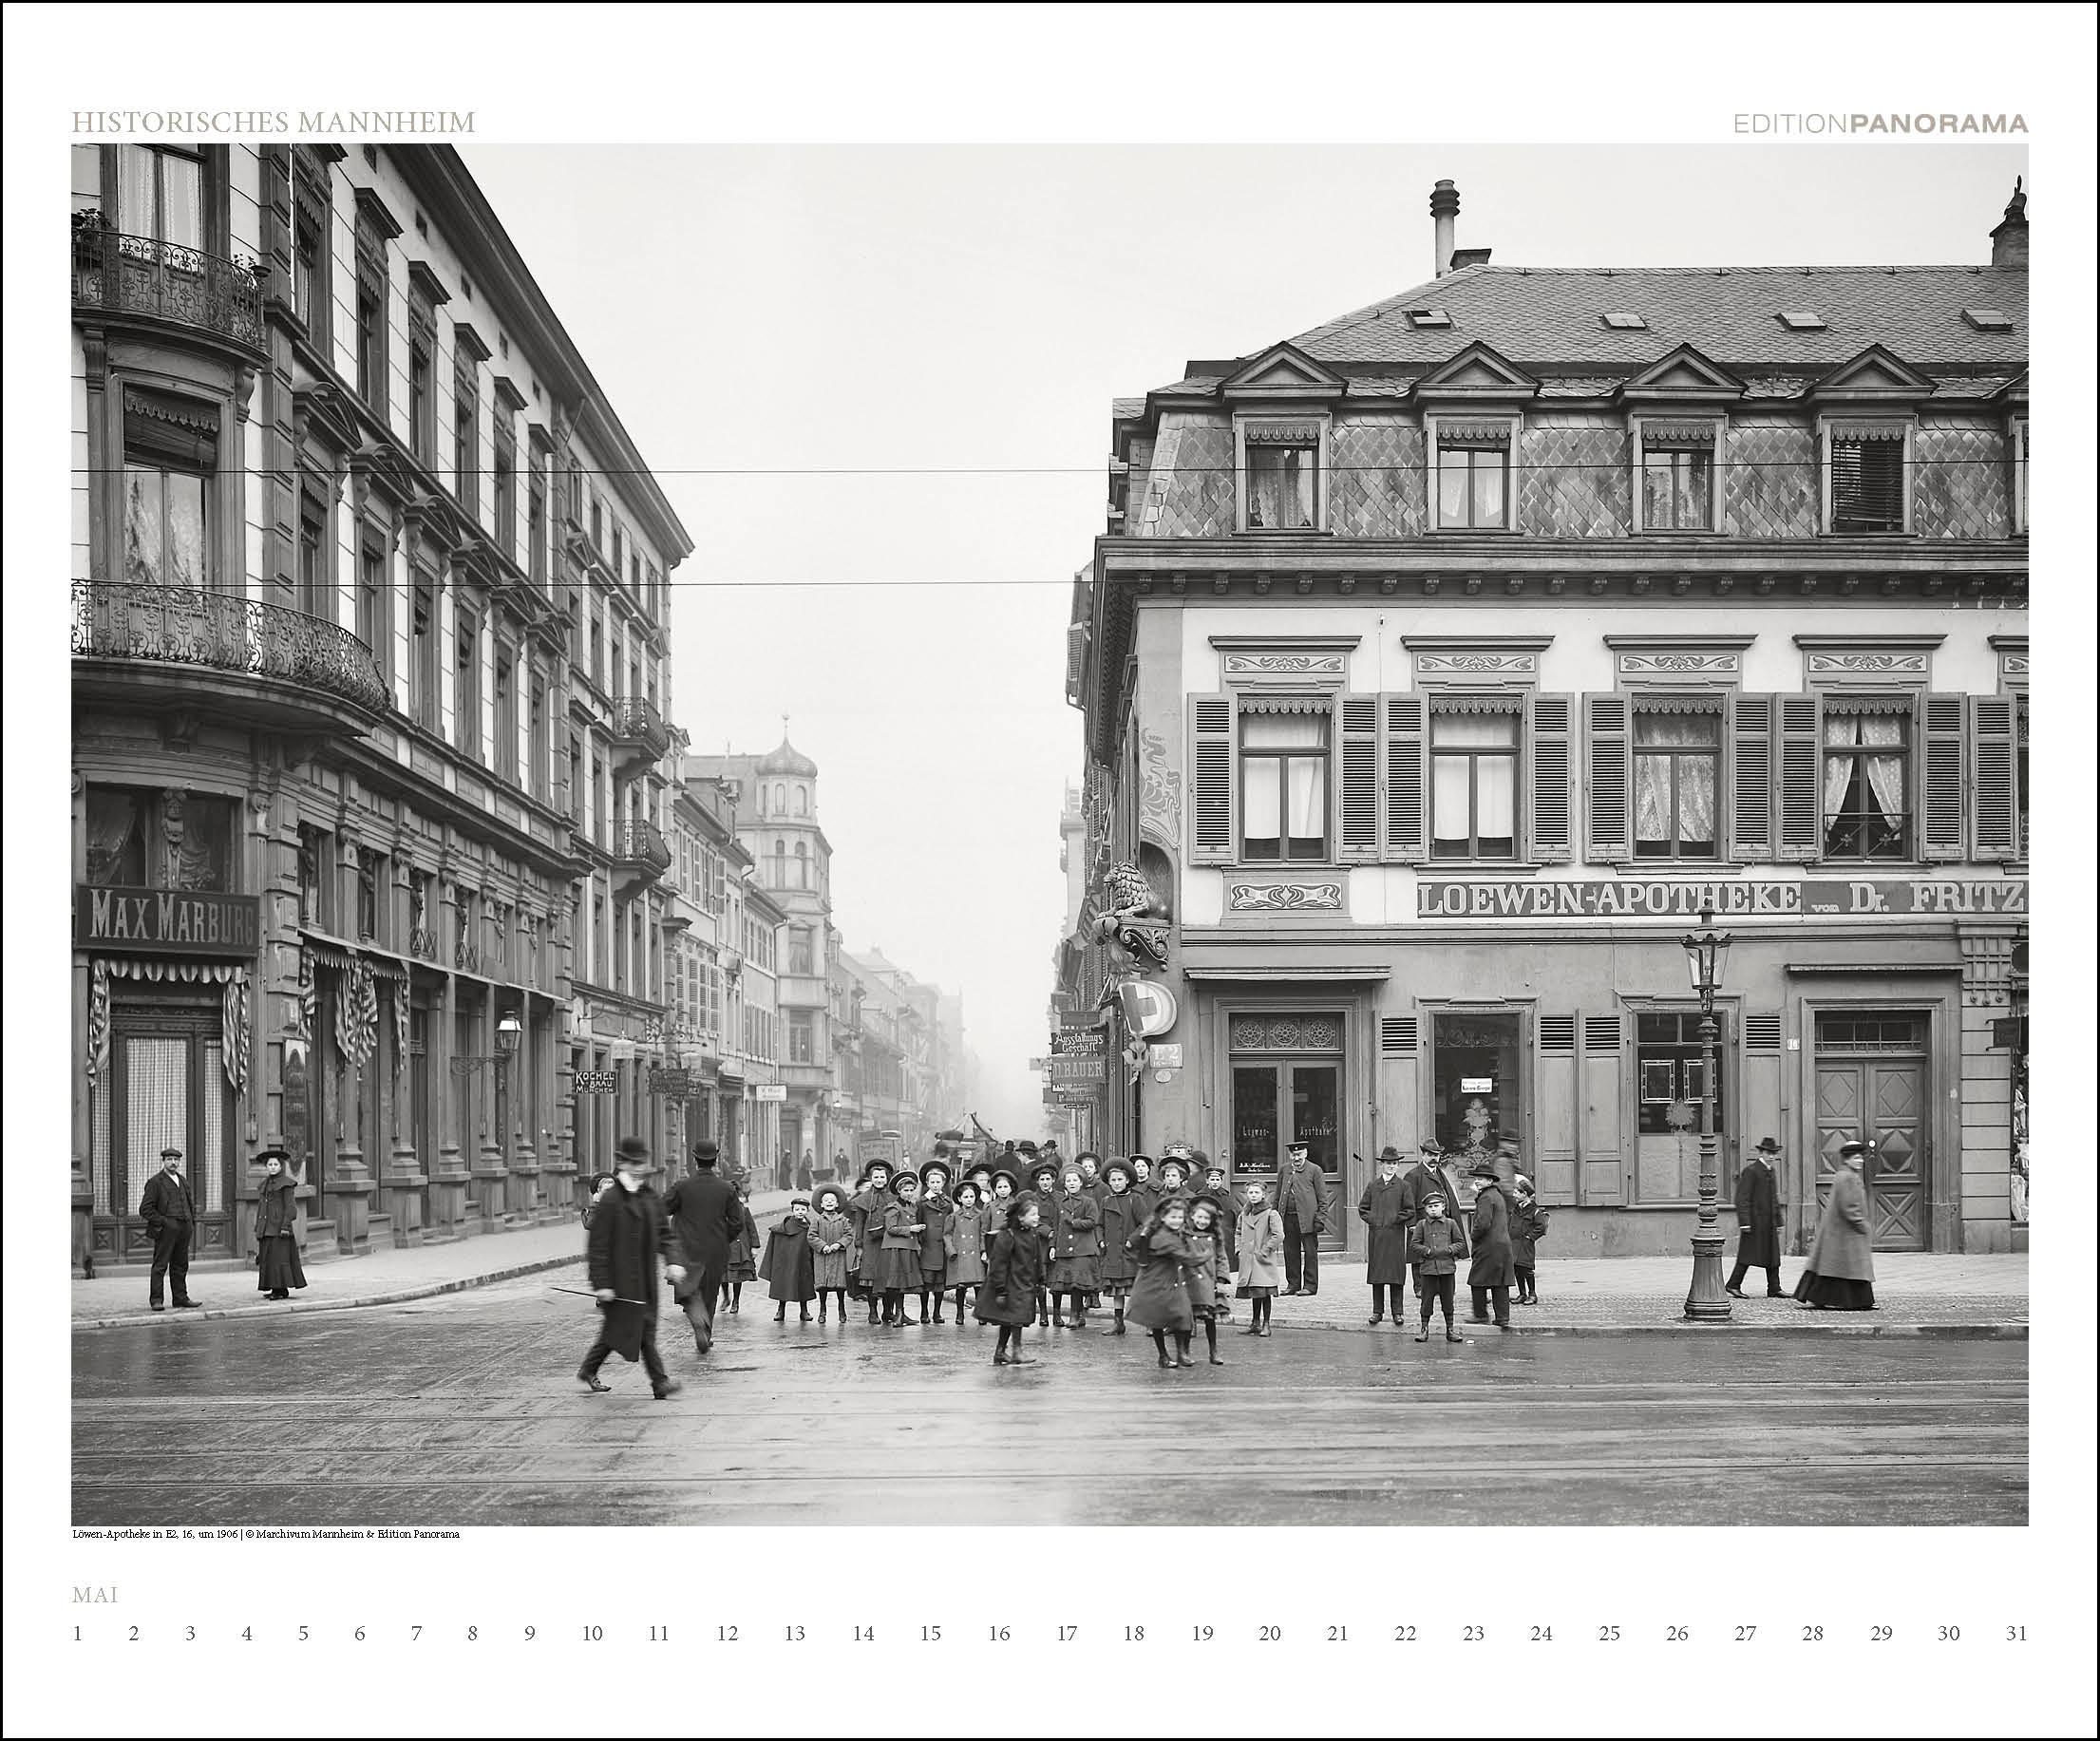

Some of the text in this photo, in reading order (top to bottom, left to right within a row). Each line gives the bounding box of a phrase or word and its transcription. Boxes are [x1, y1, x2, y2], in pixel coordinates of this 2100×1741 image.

[89, 888, 254, 946] MAX MARBURG
[1418, 881, 2025, 915] LOEWEN-APOTHEKE von Dr. FRITZ
